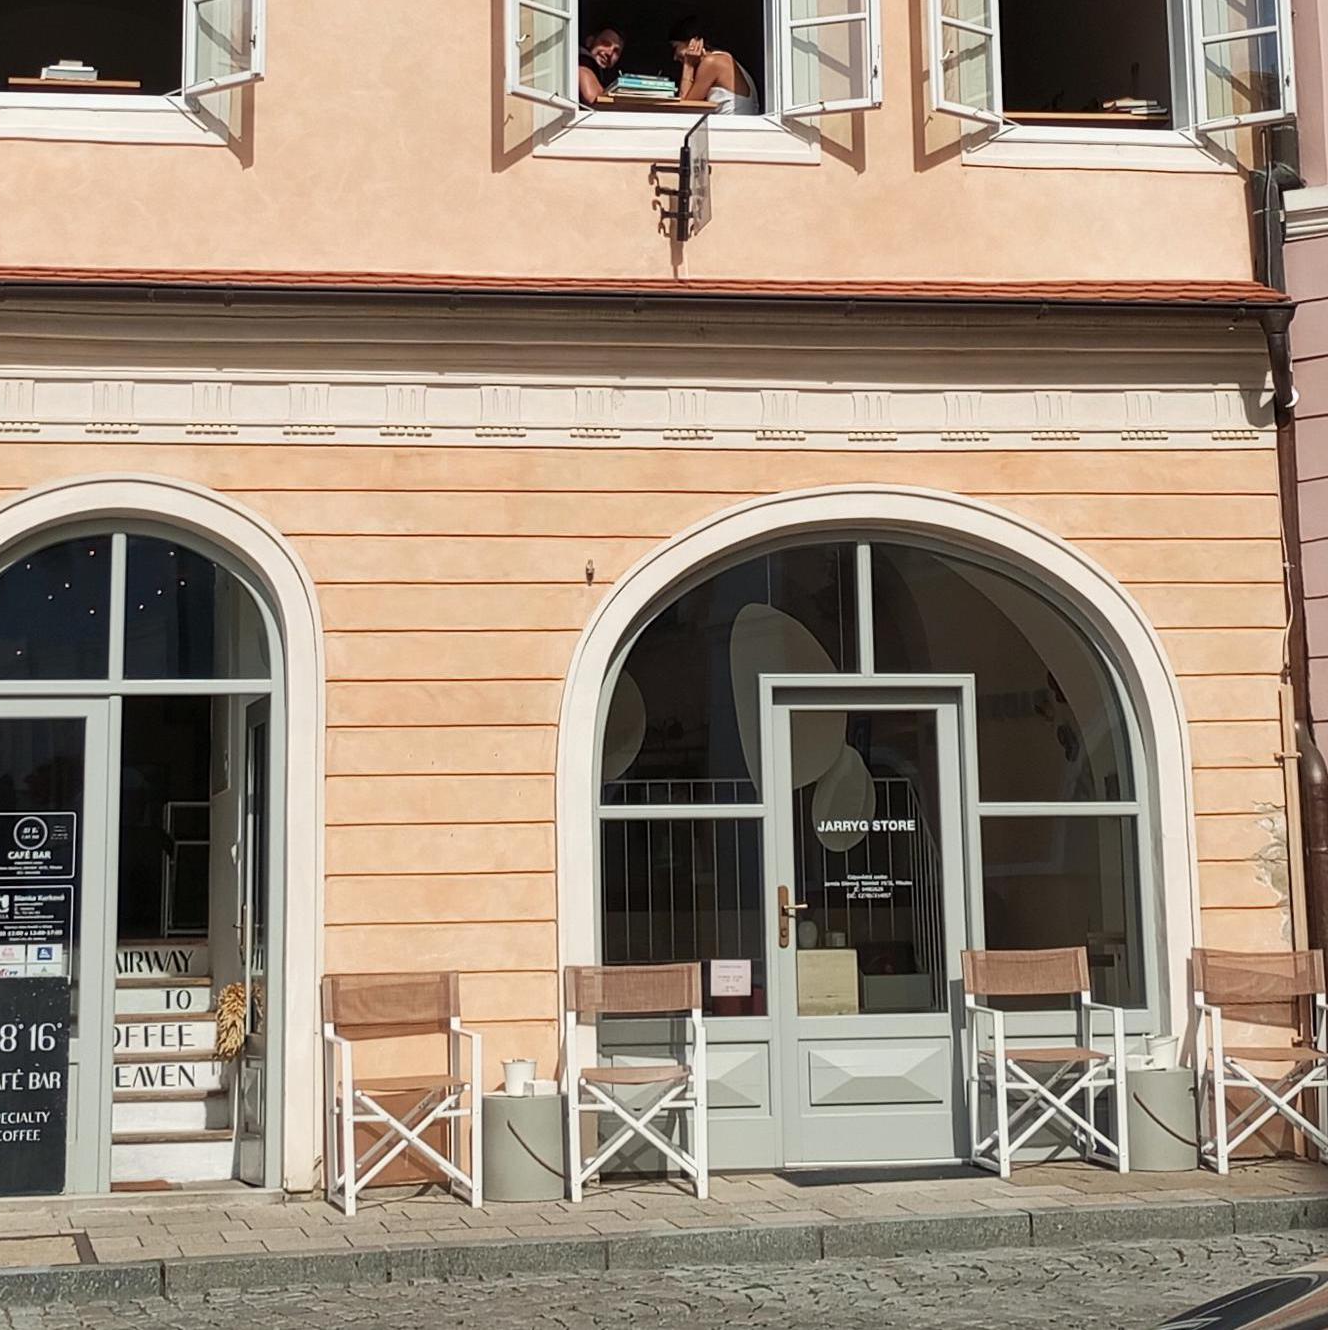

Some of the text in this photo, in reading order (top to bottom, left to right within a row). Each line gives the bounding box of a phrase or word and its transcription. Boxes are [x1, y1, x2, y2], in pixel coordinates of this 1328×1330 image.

[818, 820, 916, 832] JARRYG STORE
[32, 850, 52, 860] BAR
[161, 989, 193, 1010] TO
[28, 1071, 62, 1090] BAR
